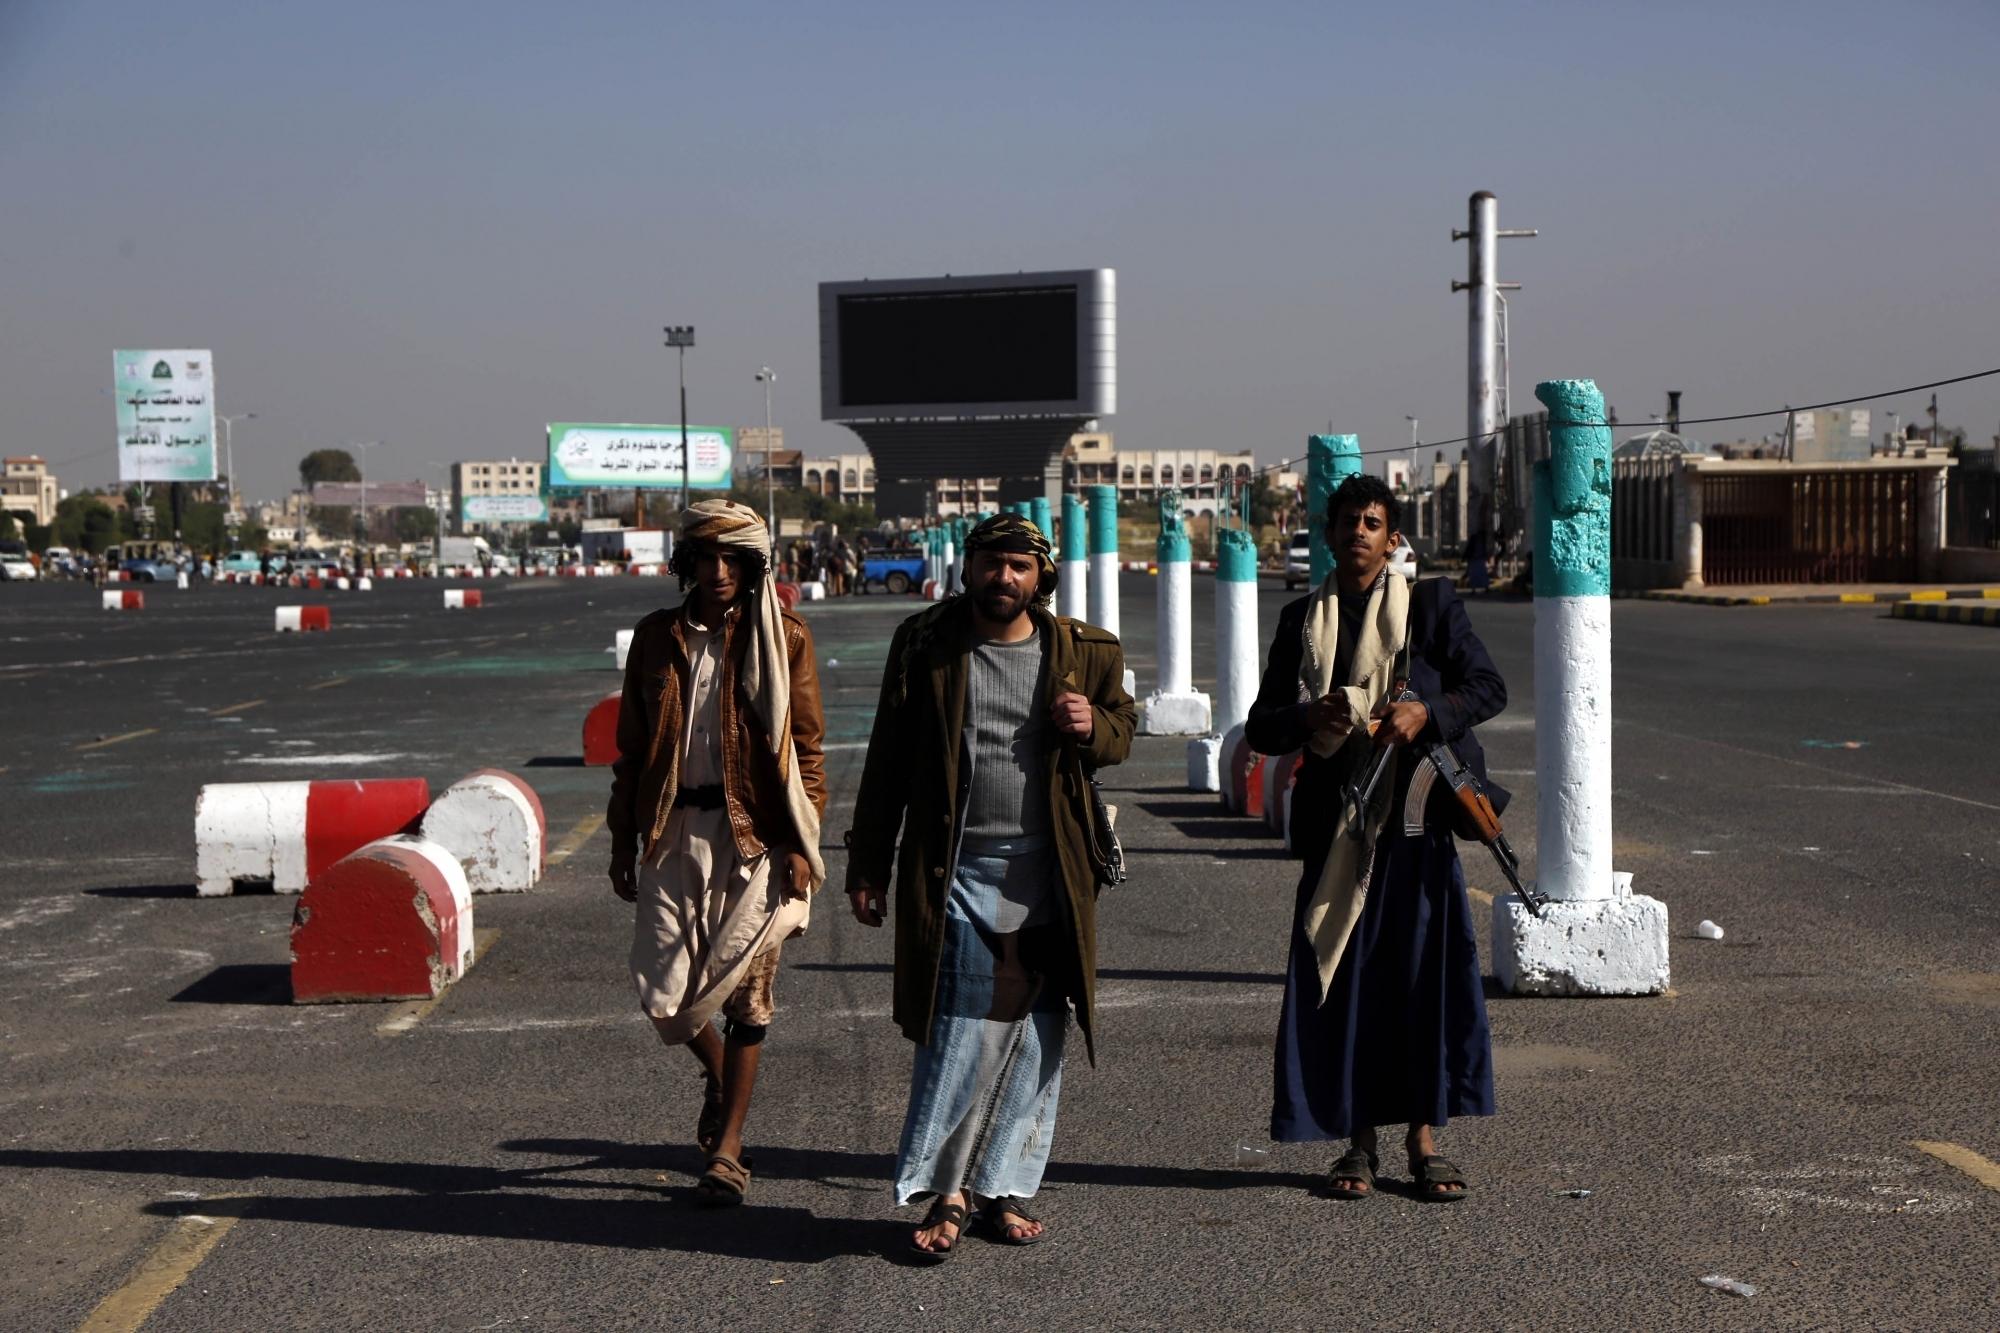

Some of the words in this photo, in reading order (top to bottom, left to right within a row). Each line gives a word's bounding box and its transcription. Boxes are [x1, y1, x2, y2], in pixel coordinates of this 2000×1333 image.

[164, 434, 206, 448] الرسول
[632, 439, 657, 452] بقدوم
[600, 457, 631, 471] الشريف
